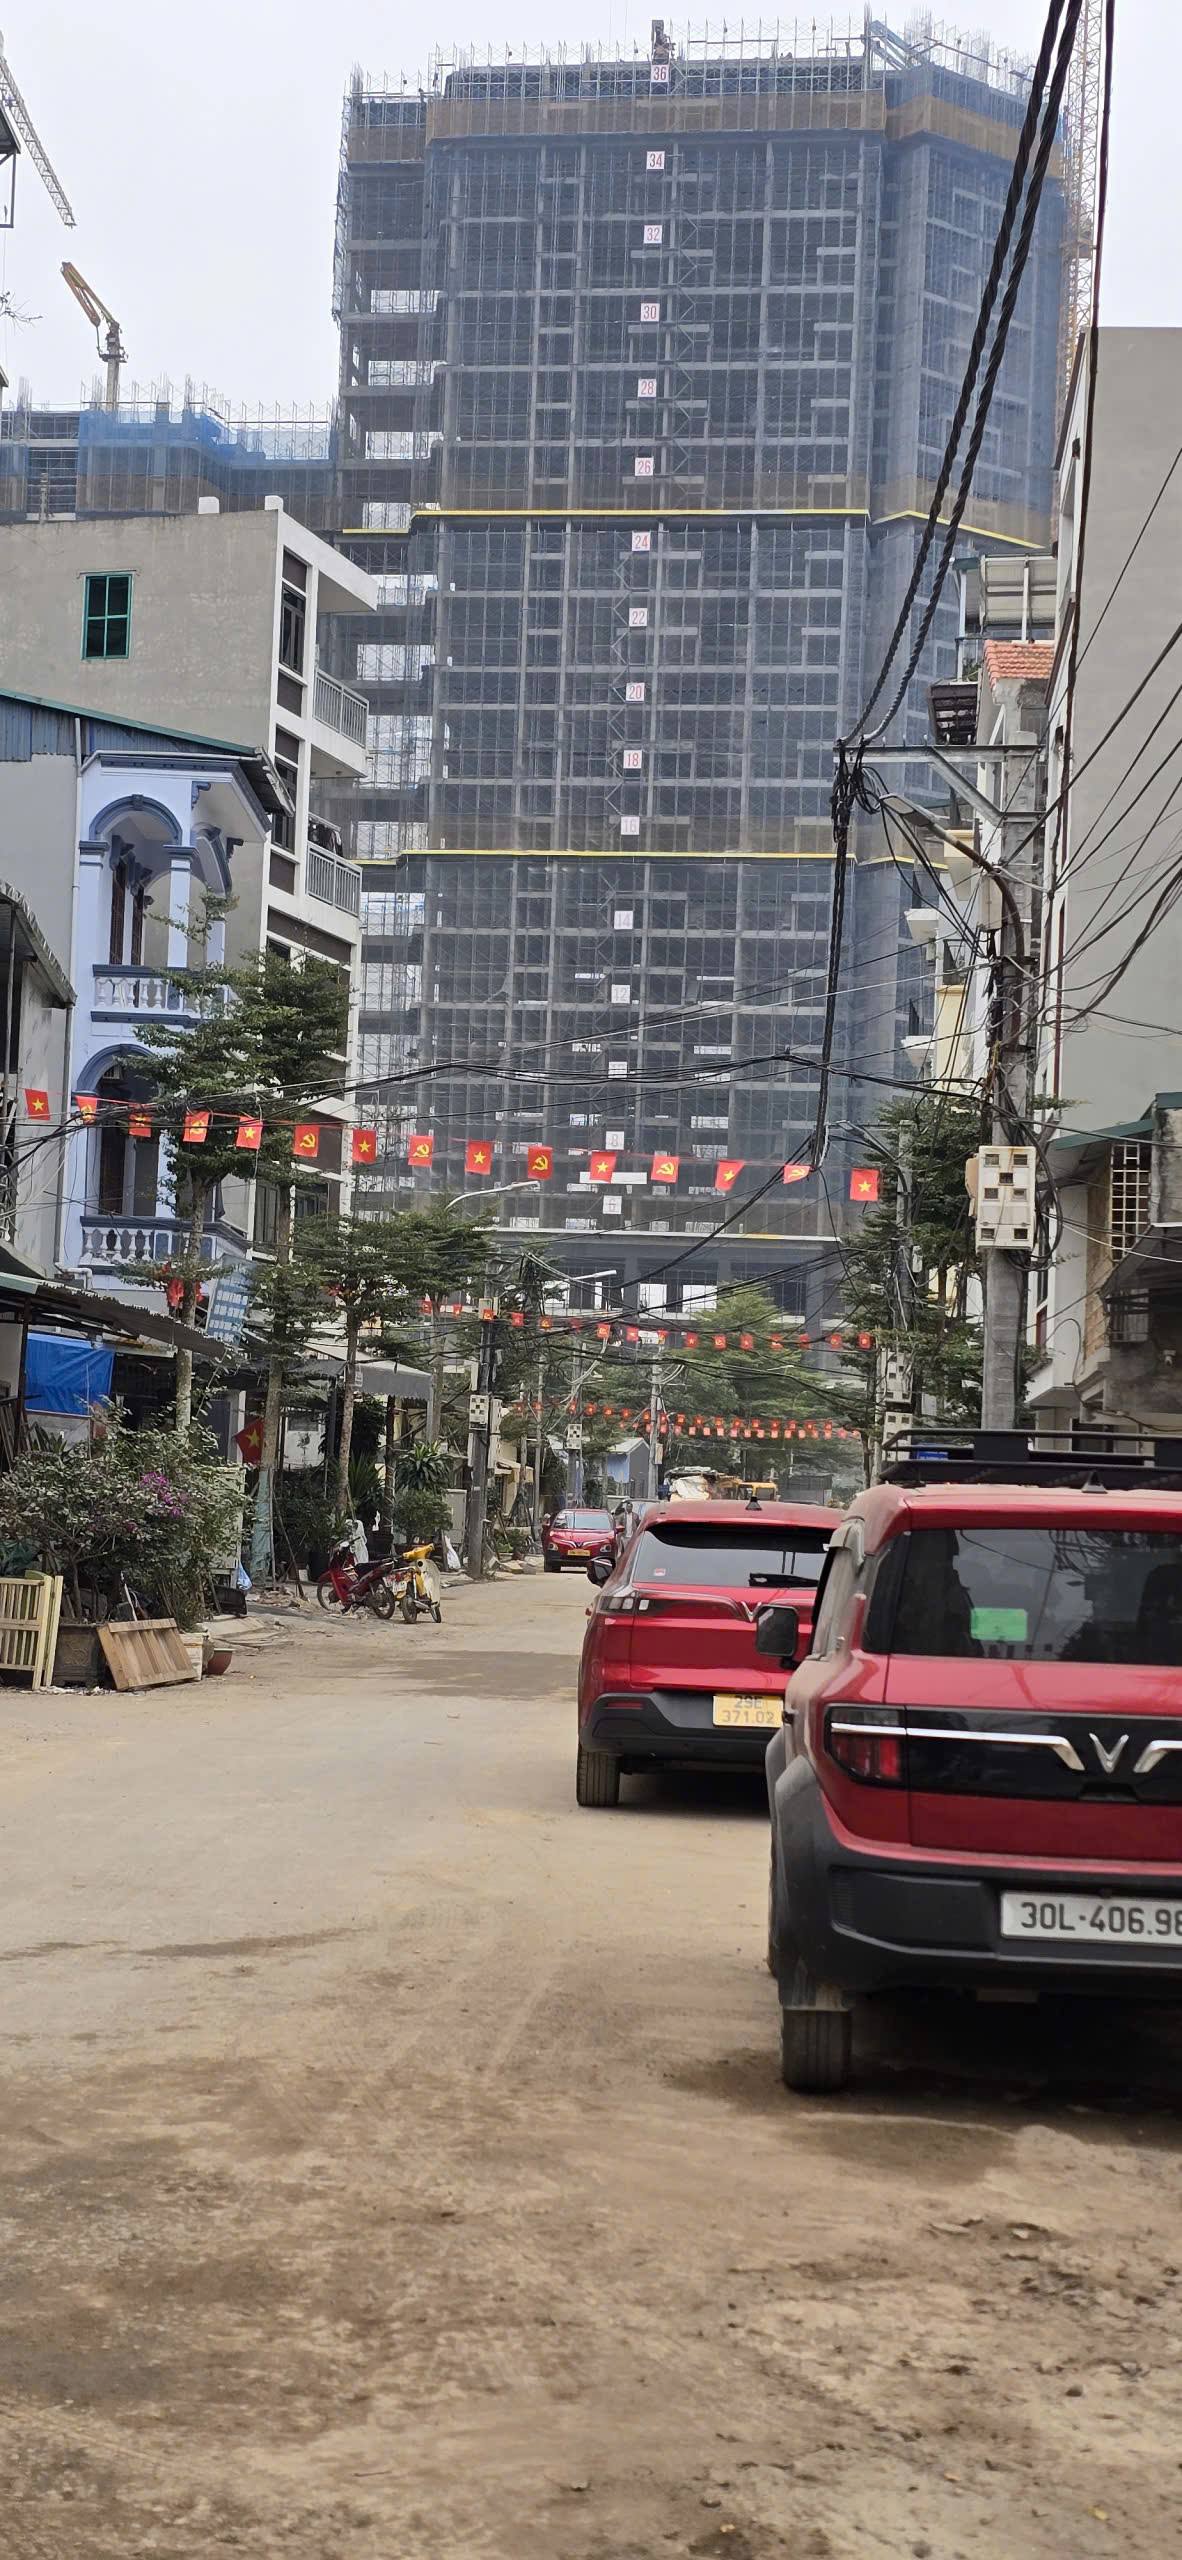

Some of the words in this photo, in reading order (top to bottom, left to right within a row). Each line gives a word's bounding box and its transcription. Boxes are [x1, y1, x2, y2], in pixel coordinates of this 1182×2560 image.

[653, 66, 667, 81] 36
[649, 153, 662, 168] 34
[647, 227, 660, 242] 32
[643, 305, 657, 320] 30
[640, 380, 654, 395] 28
[638, 459, 651, 474] 26
[635, 535, 648, 549] 24
[632, 610, 645, 625] 22
[629, 685, 642, 700] 20
[627, 752, 639, 767] 18
[624, 818, 637, 834] 16
[617, 913, 631, 928] 14
[614, 987, 627, 1002] 12
[722, 1709, 774, 1724] 371.02
